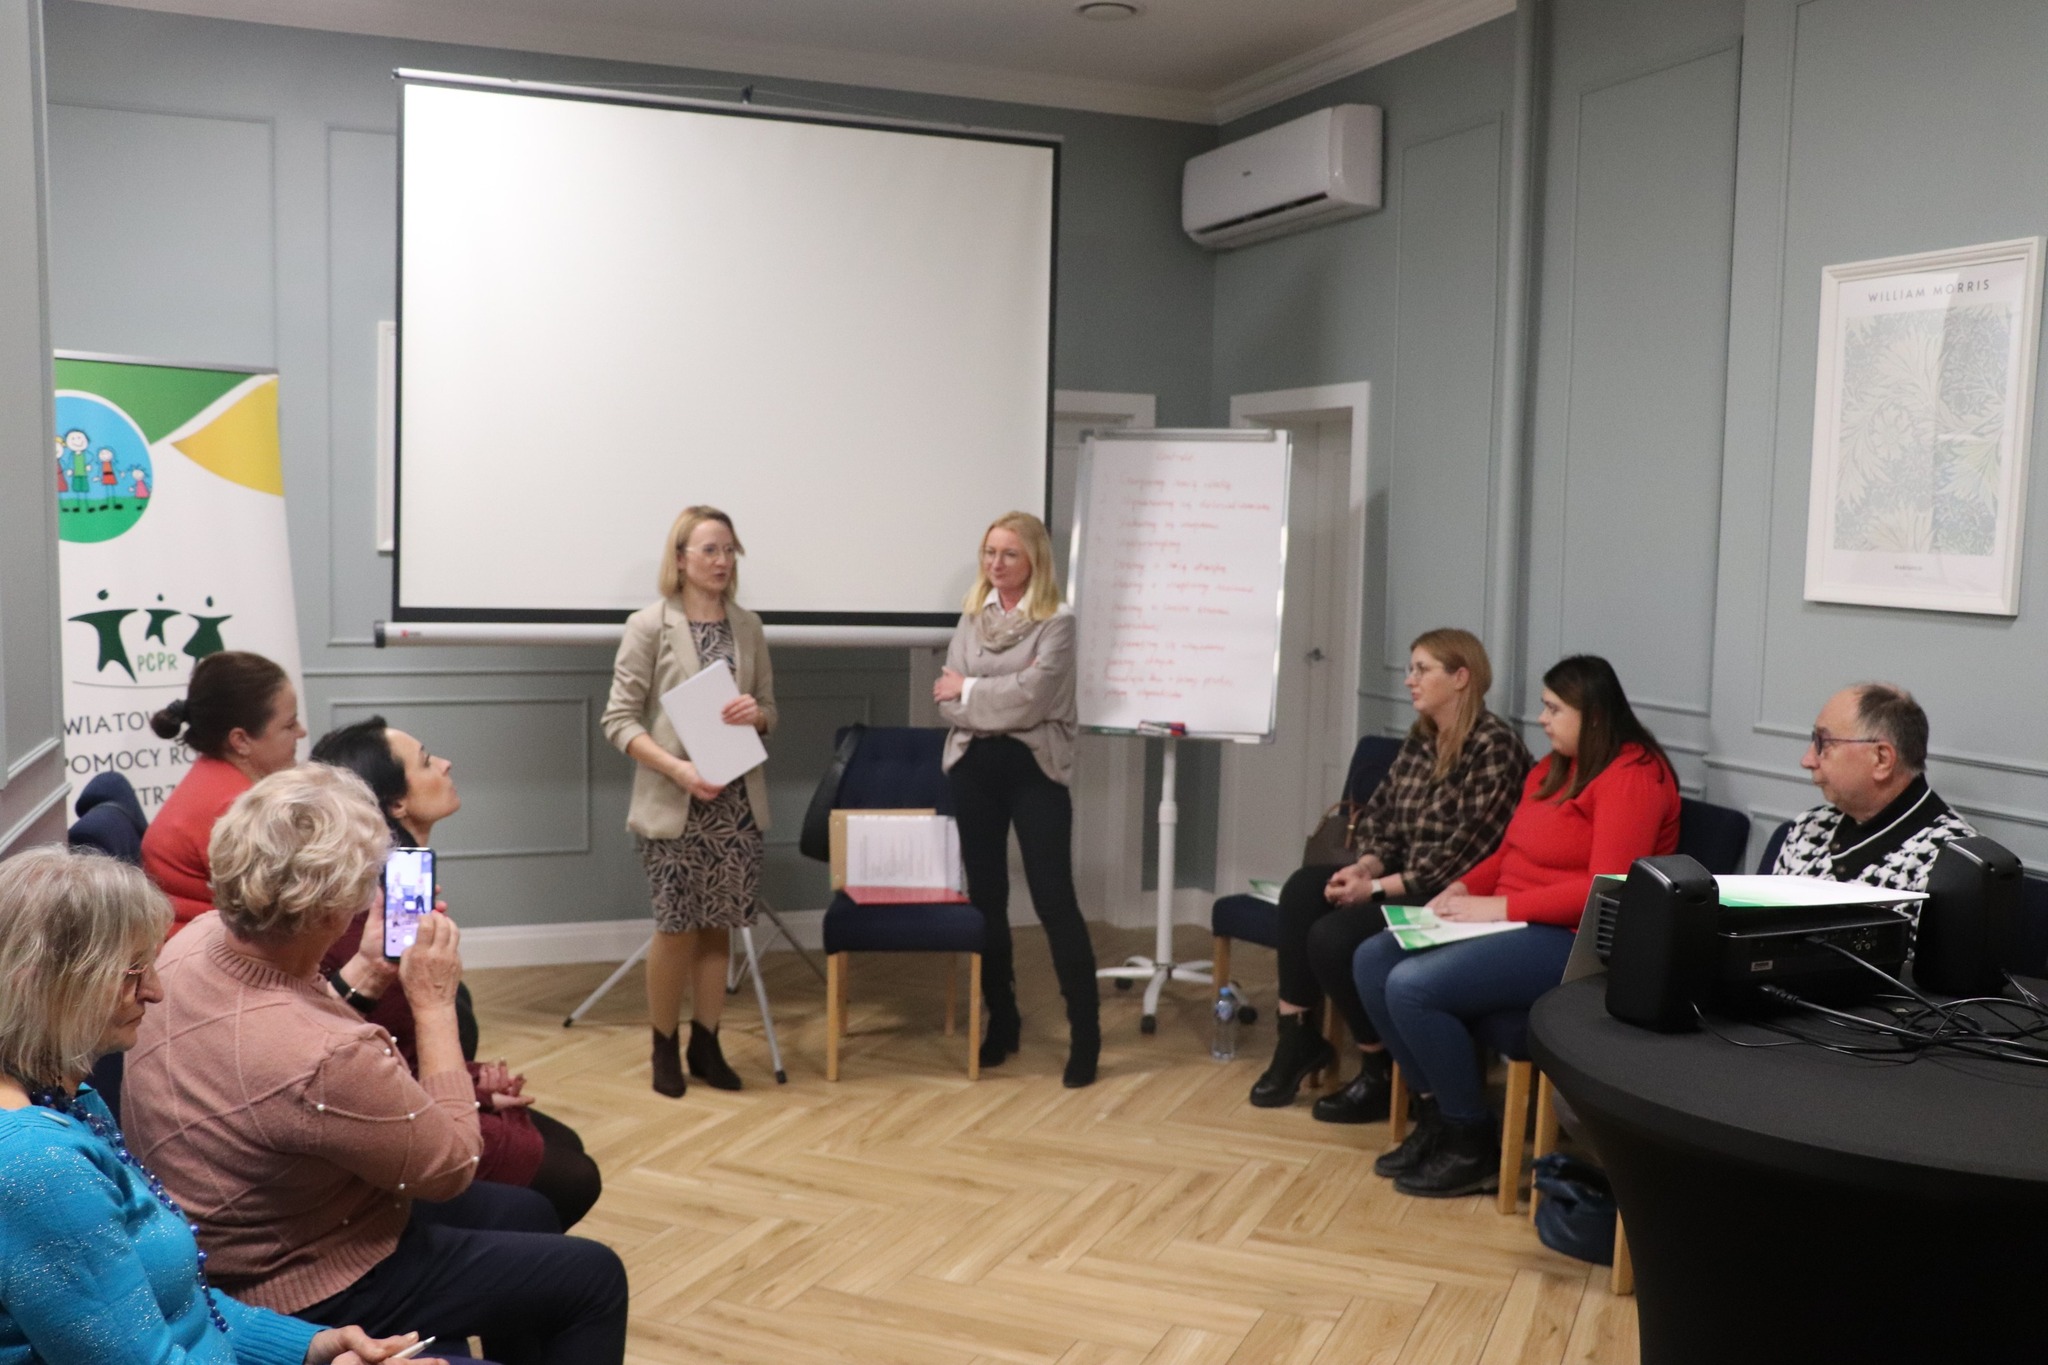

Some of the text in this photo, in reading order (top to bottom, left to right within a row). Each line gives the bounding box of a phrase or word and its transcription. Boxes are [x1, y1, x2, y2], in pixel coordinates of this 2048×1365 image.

[1868, 279, 1990, 302] WILLIAM MORRIS
[137, 652, 178, 671] PCPR
[64, 711, 152, 735] WIATO
[64, 749, 161, 774] OMOCY
